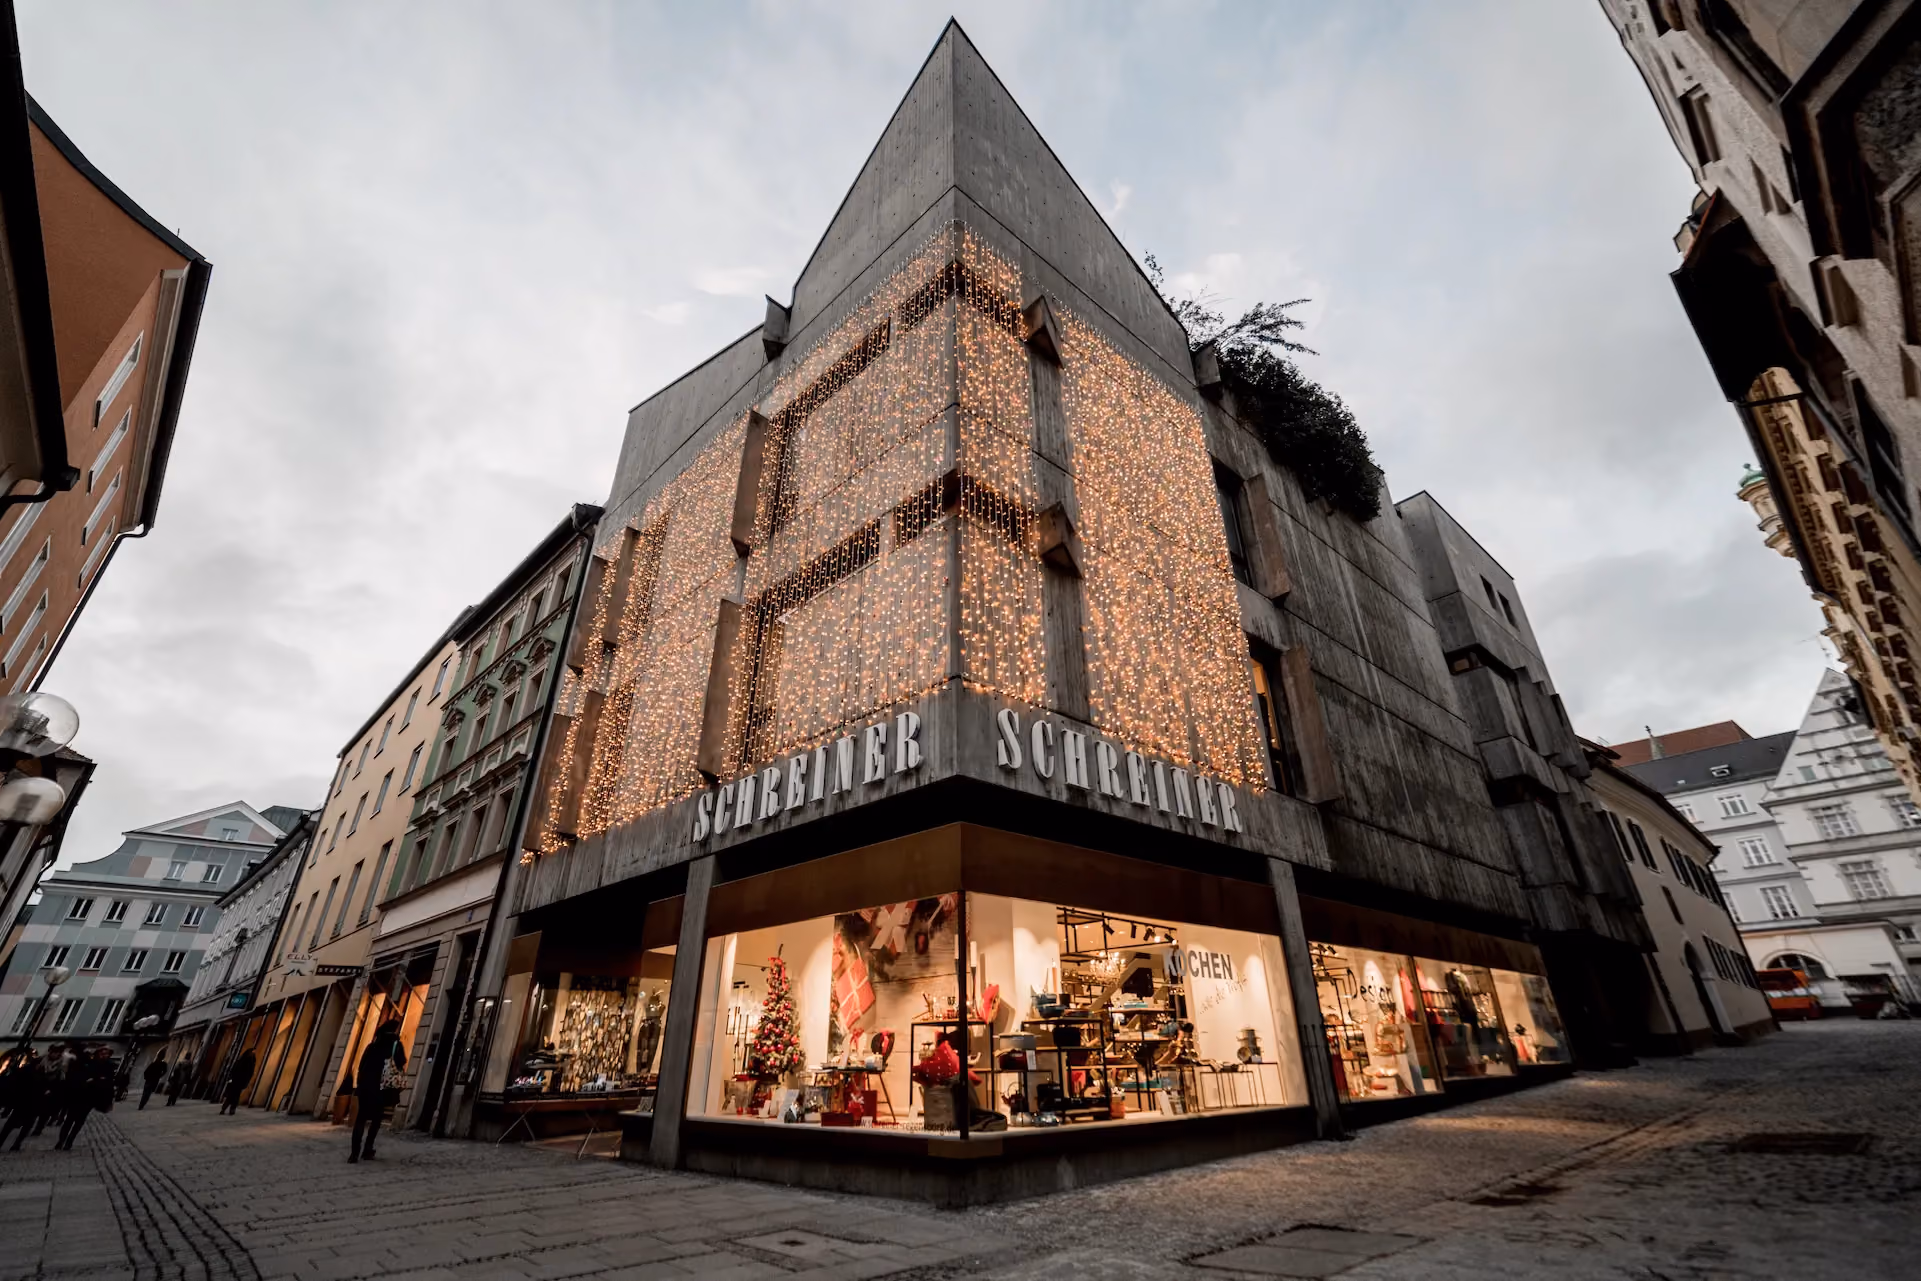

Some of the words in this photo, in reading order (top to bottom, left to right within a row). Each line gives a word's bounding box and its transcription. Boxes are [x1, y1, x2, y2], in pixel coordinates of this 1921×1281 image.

[692, 711, 924, 842] SCHREINER
[997, 708, 1243, 833] SCHREINER
[1163, 947, 1234, 980] KOCHEN
